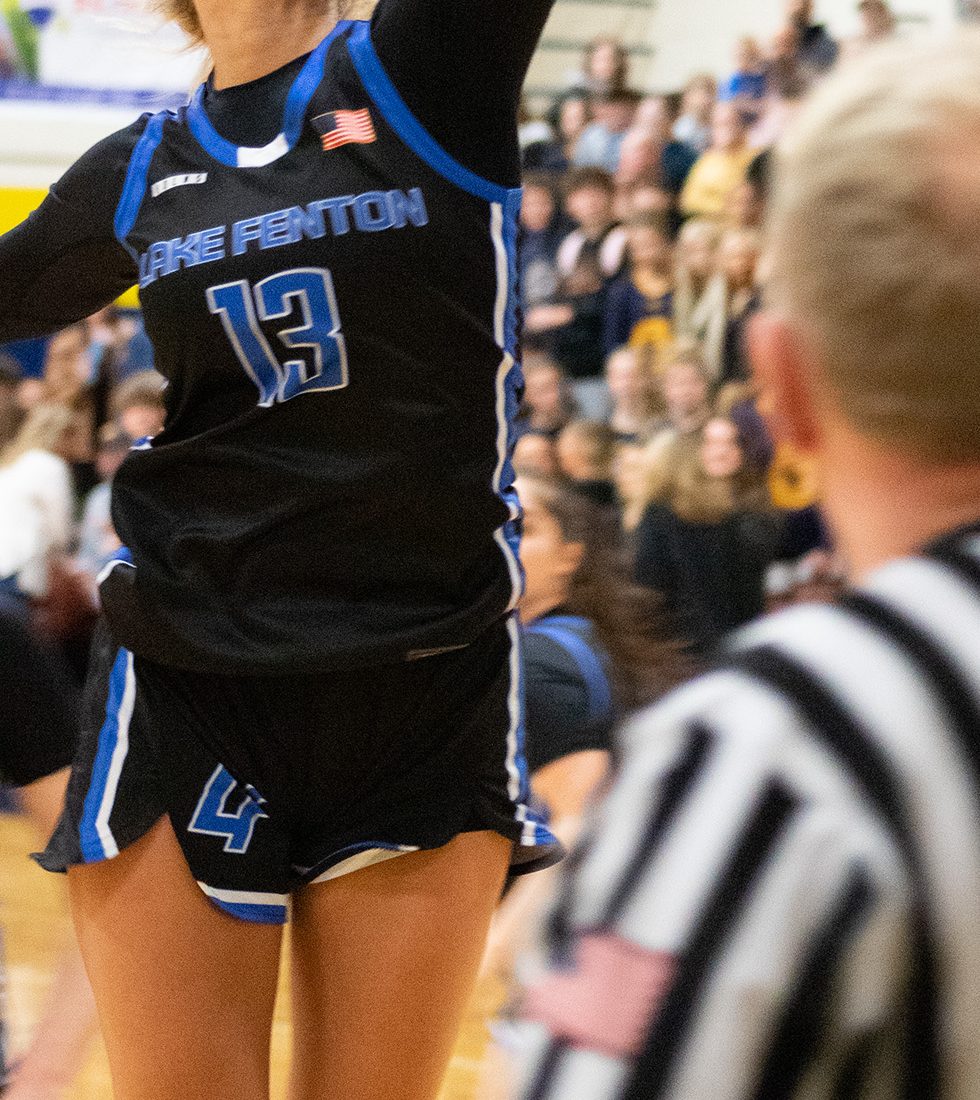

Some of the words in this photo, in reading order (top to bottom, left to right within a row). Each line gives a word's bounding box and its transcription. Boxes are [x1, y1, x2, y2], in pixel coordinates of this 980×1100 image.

[139, 225, 226, 290] LAKE
[231, 187, 429, 256] FENTON
[206, 266, 348, 408] 13
